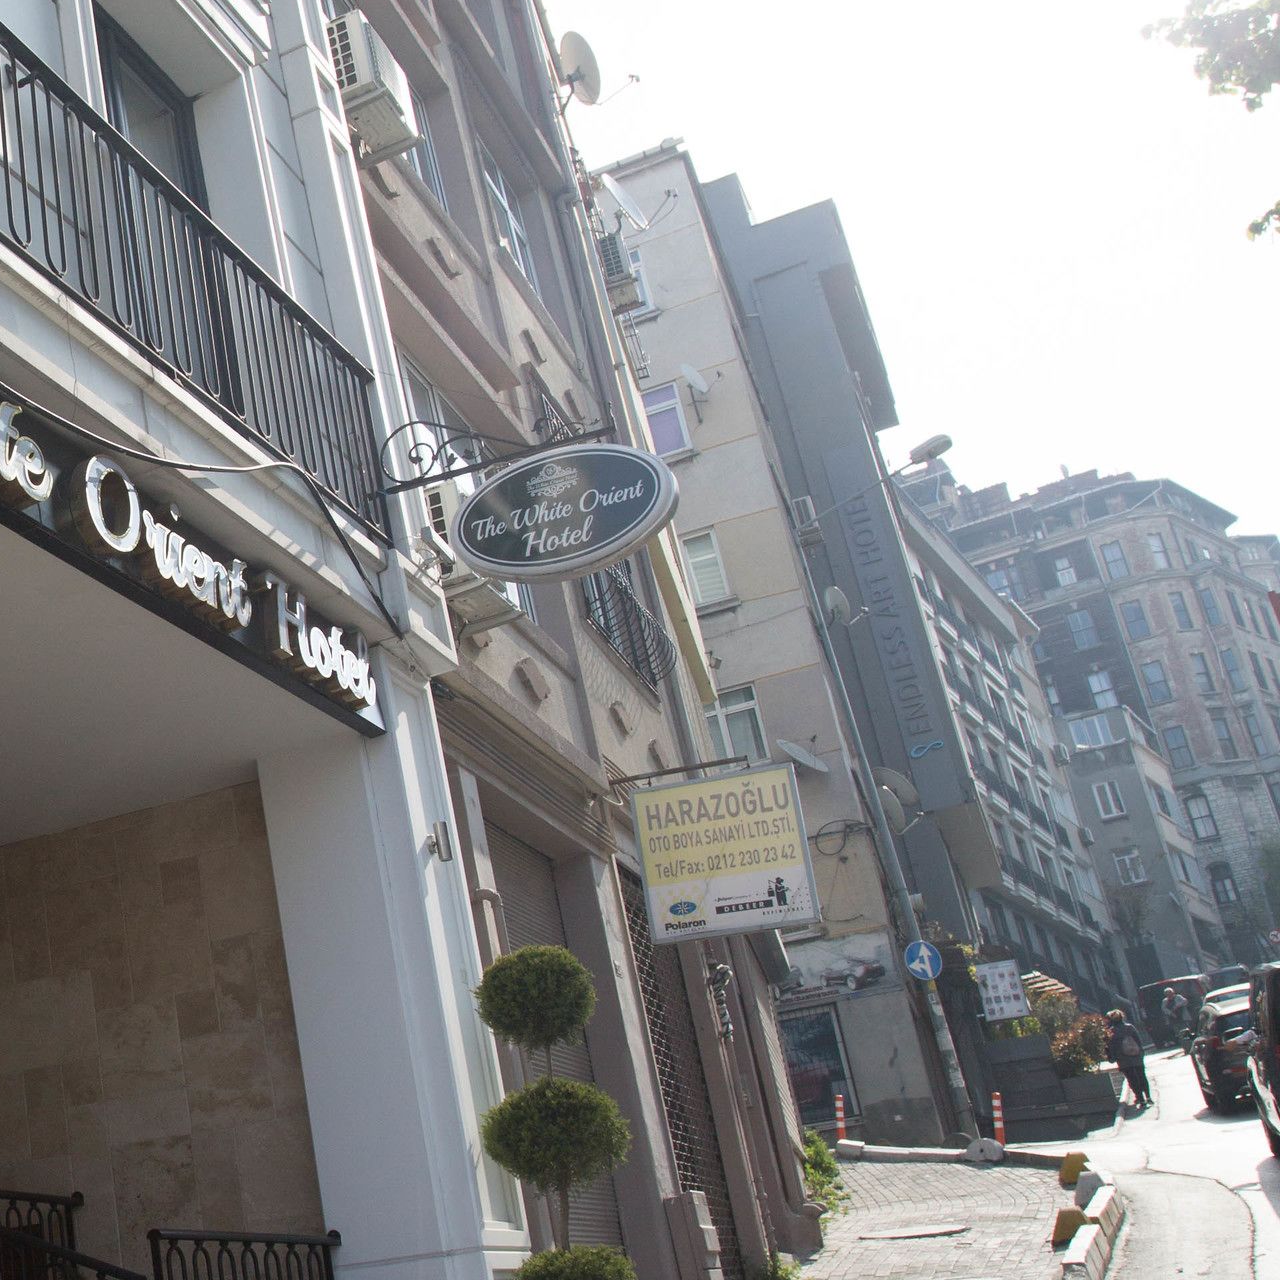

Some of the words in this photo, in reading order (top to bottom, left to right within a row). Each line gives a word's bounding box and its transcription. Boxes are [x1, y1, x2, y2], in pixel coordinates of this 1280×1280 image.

[470, 517, 507, 542] The
[510, 500, 574, 531] White
[579, 479, 644, 513] Orient
[521, 514, 593, 557] Hotel
[85, 455, 252, 628] Orient
[265, 572, 377, 706] Hotel
[869, 576, 899, 619] ART
[880, 625, 934, 736] ENDLESS
[645, 781, 789, 830] HARAZOĞLU
[648, 835, 671, 854] OTO
[673, 830, 703, 850] BOYA
[705, 819, 745, 845] SANAYİ
[654, 860, 705, 879] Tel/Fax:
[707, 853, 736, 871] 0212
[739, 849, 760, 866] 230
[764, 847, 778, 863] 23
[781, 843, 796, 859] 42
[665, 919, 707, 931] Polaron
